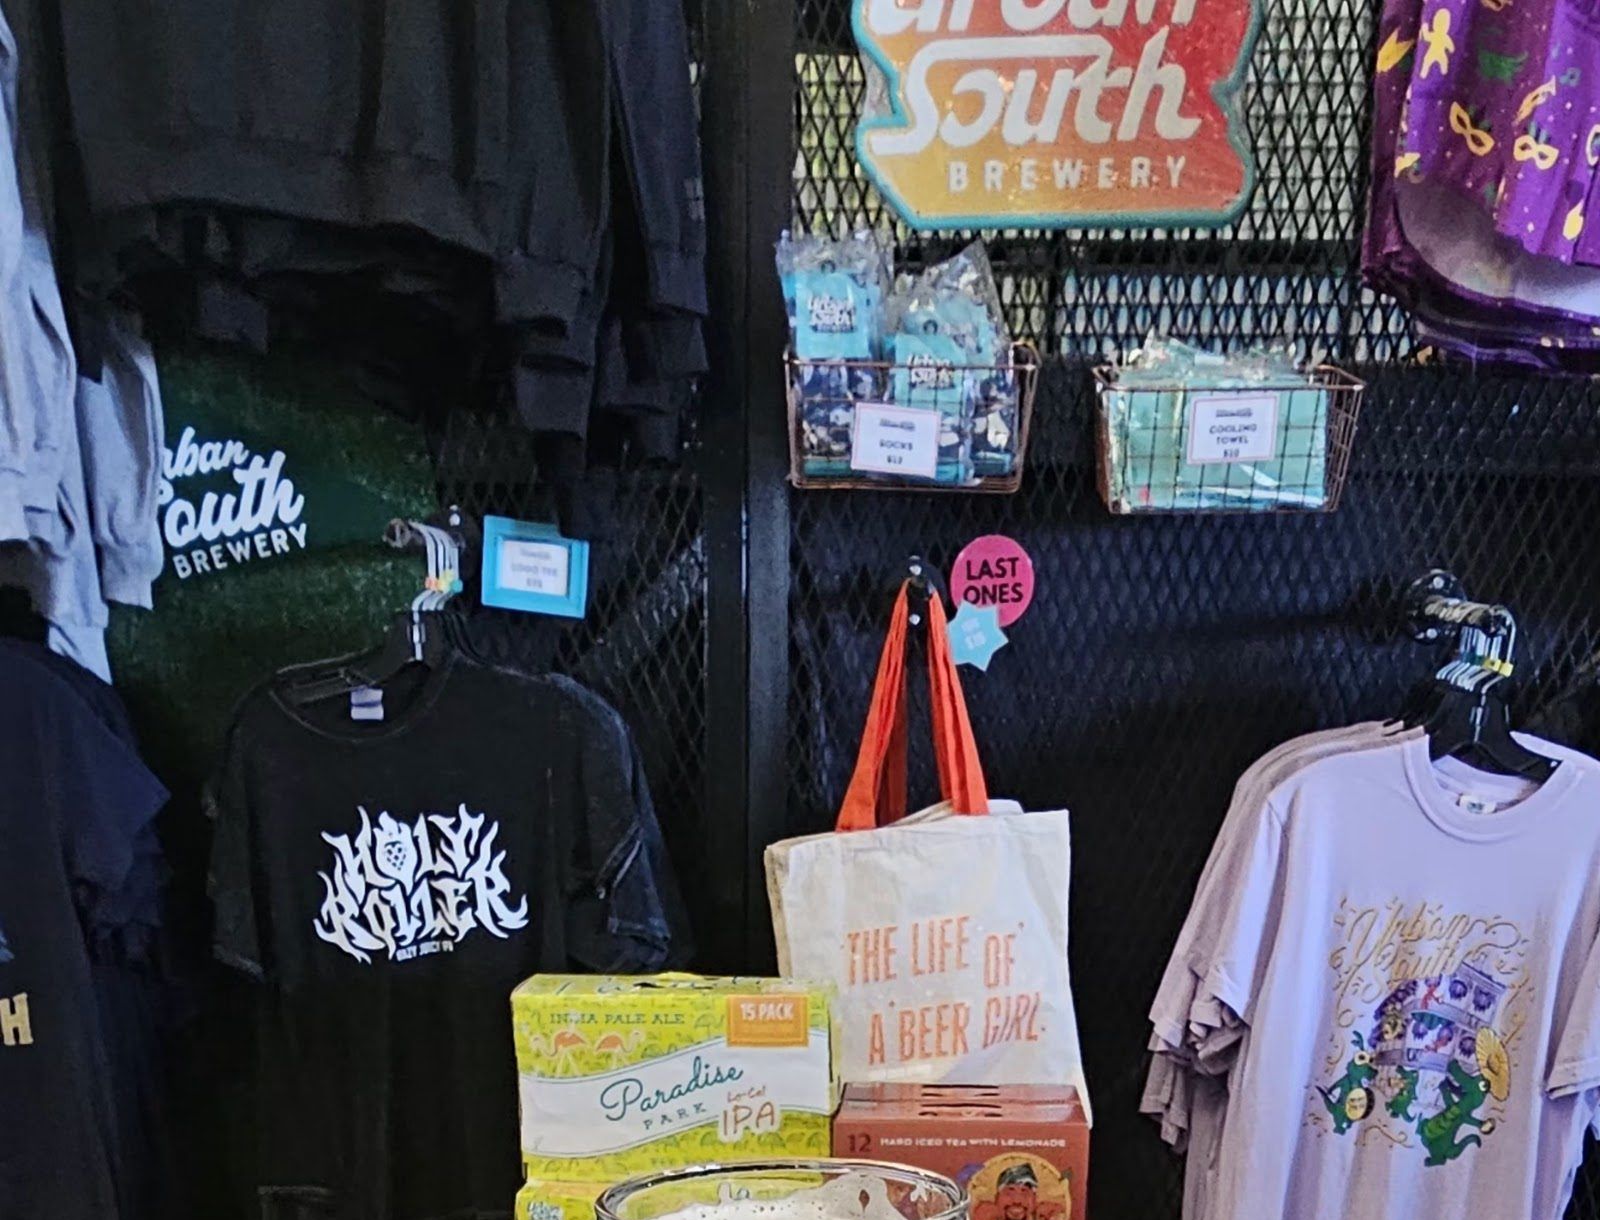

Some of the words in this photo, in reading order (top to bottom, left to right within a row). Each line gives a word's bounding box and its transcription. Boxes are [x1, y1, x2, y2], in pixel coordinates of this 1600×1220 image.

[869, 25, 1203, 157] South
[948, 155, 1188, 192] BREWERY
[1208, 423, 1258, 435] COOLING
[161, 426, 250, 480] rban
[158, 450, 306, 548] outh
[172, 522, 308, 580] BREWERY
[965, 556, 1020, 581] LAST
[963, 582, 1024, 606] ONES
[320, 802, 484, 906] HOLY
[847, 925, 899, 986] THE
[911, 914, 971, 977] LIFE
[983, 932, 1017, 989] OF
[604, 1011, 647, 1025] PALE
[652, 1012, 686, 1025] ALE
[740, 1002, 757, 1021] 15
[758, 1002, 796, 1022] PACK
[868, 1012, 886, 1067] A
[898, 1001, 971, 1063] BEER
[599, 1055, 745, 1122] Paradise
[642, 1101, 708, 1131] PARK
[722, 1101, 776, 1137] IPA
[848, 1132, 872, 1153] 12
[880, 1137, 912, 1147] HARD
[915, 1137, 944, 1147] ICED
[946, 1138, 967, 1147] TEA
[969, 1137, 998, 1147] WITH
[1000, 1138, 1067, 1149] LEMONADE
